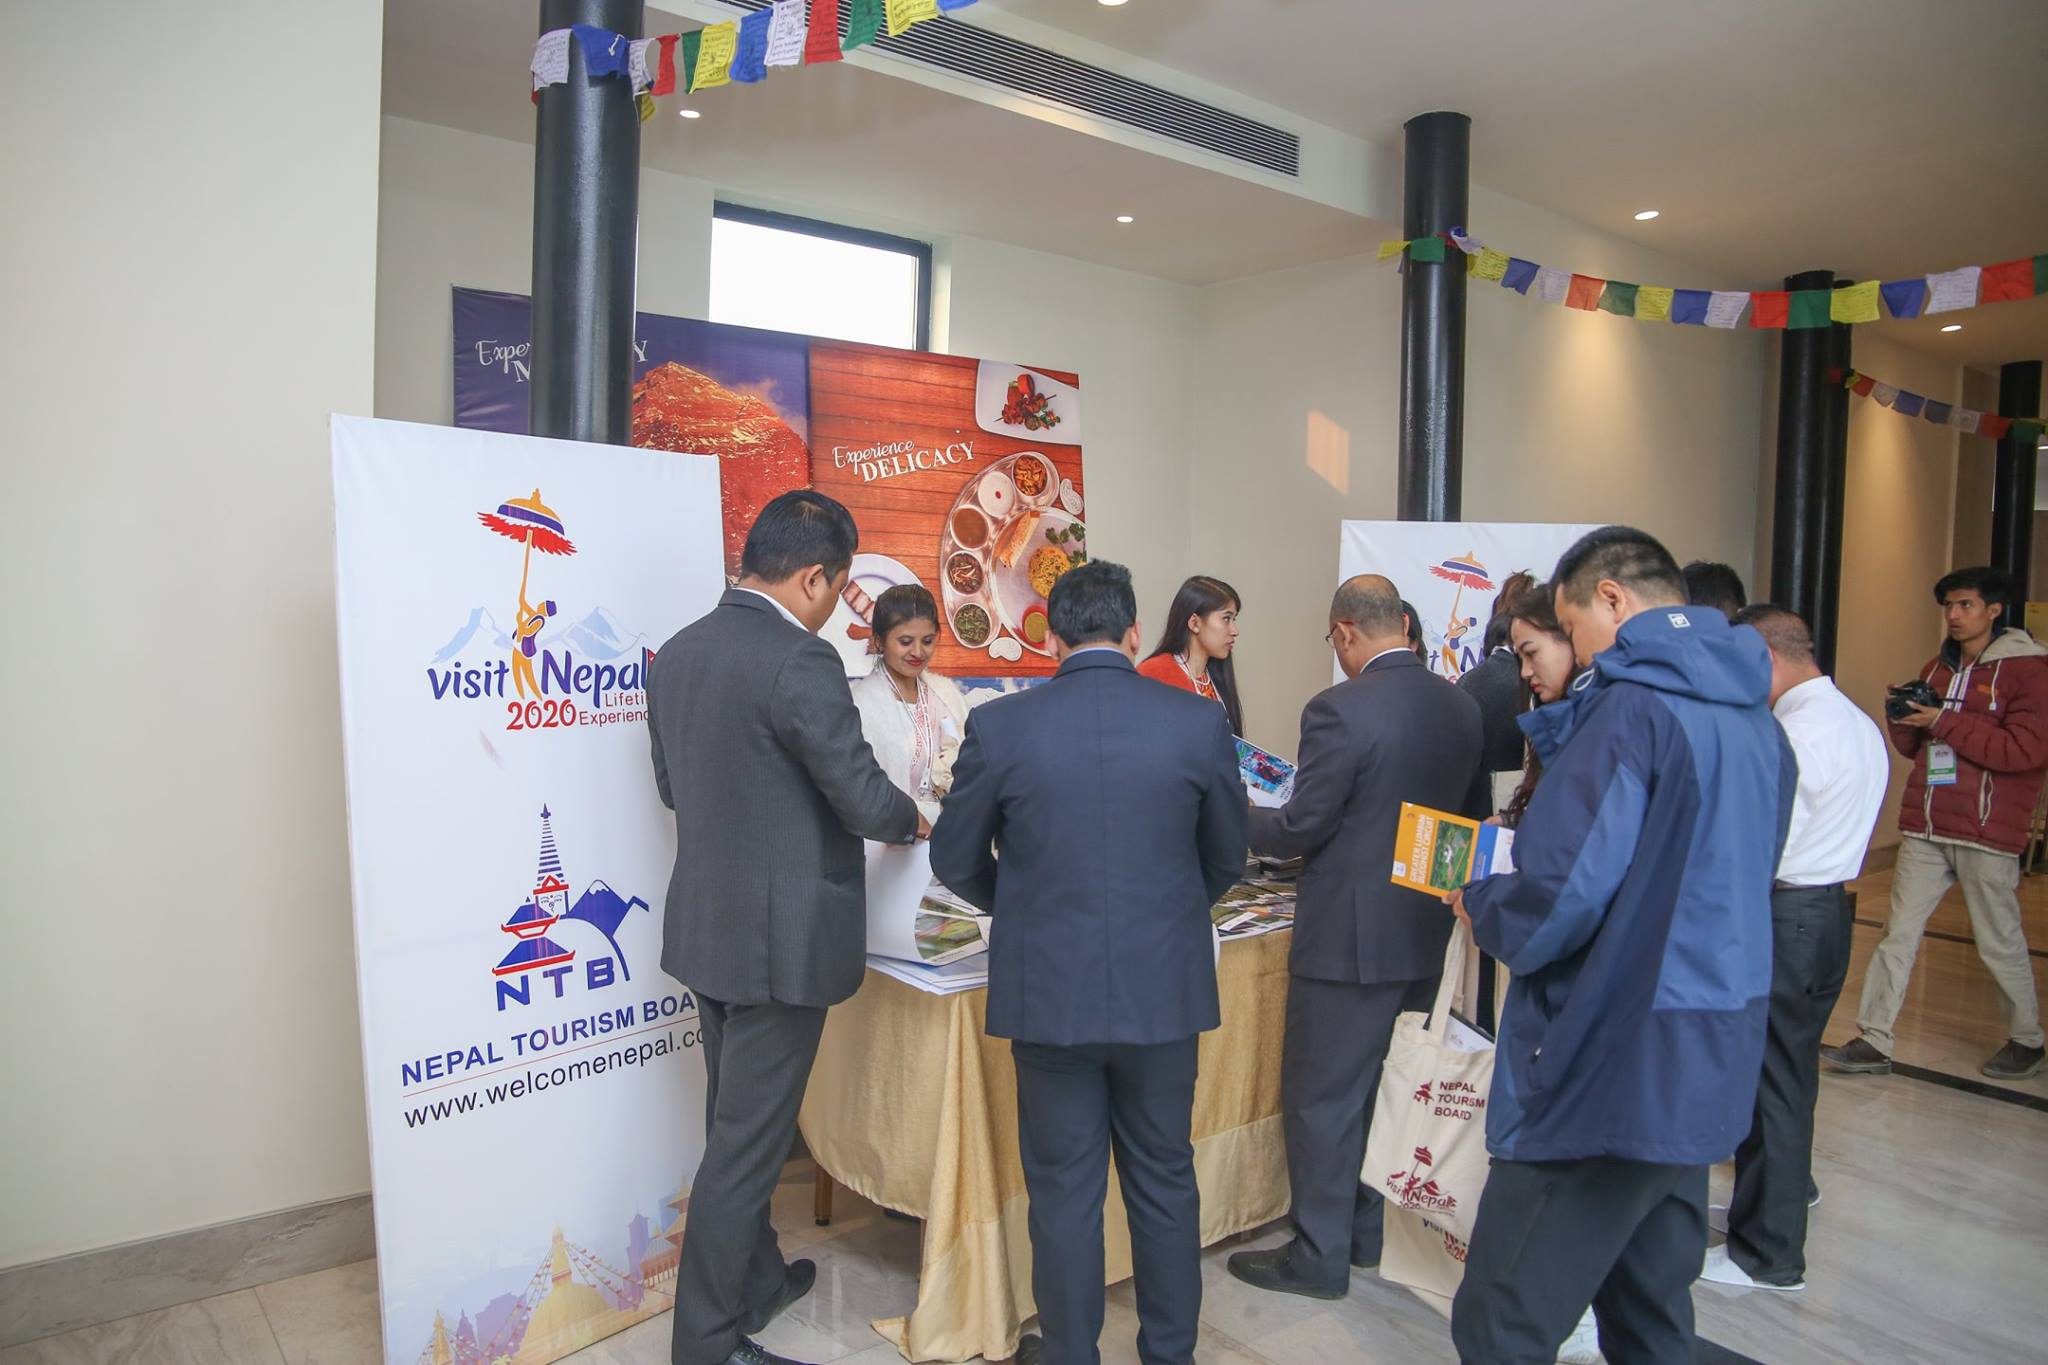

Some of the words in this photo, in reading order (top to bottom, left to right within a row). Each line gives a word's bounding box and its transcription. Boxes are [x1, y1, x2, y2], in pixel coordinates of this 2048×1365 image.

[831, 439, 915, 476] Experience
[859, 441, 976, 483] DELICACY
[541, 646, 648, 709] Nepal
[506, 698, 577, 731] 2020
[579, 708, 649, 728] Experienc
[605, 691, 648, 708] Lifeti
[401, 1042, 504, 1087] NEPAL
[511, 1005, 635, 1057] TOURISM
[643, 992, 696, 1023] BOA
[404, 1029, 704, 1129] www.welcomenepal.co
[1440, 1081, 1477, 1093] NEPAL
